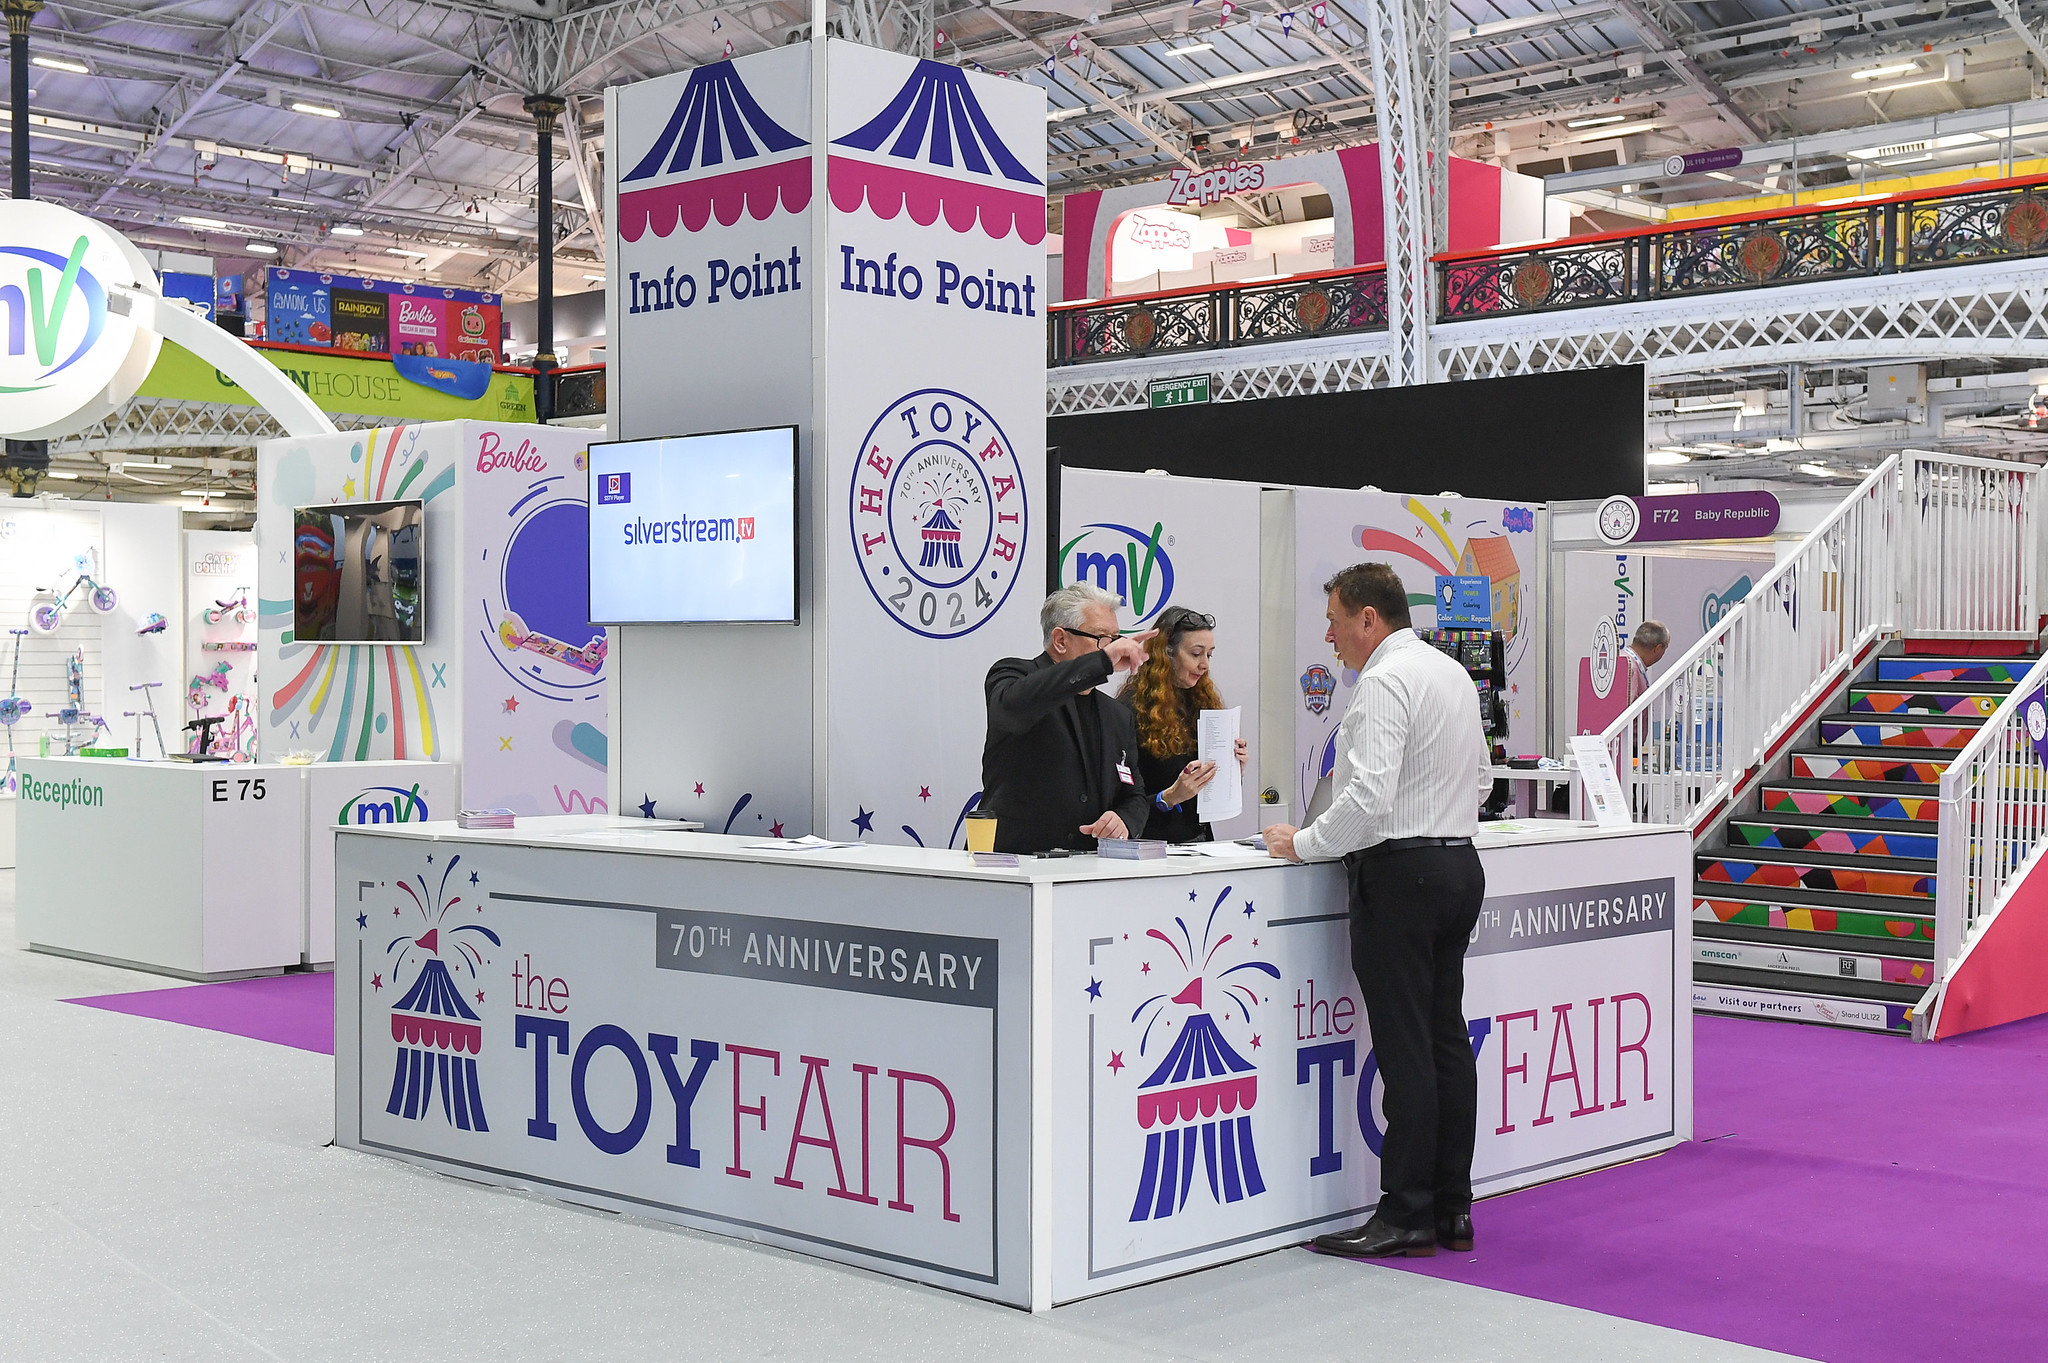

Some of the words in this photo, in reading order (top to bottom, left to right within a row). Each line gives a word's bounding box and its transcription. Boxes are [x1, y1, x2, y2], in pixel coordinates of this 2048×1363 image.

[1167, 159, 1264, 207] Zappies
[1131, 214, 1191, 250] Zappies
[1215, 250, 1247, 265] Zappies
[629, 264, 696, 314] Info
[707, 245, 801, 304] Point
[840, 244, 923, 300] Info
[936, 259, 1036, 318] Point
[273, 292, 309, 312] AMONG
[313, 296, 327, 314] US
[338, 301, 381, 316] RAINBOW
[400, 300, 436, 324] Barbie
[1152, 381, 1191, 393] EMERGENCY
[1192, 379, 1207, 388] EXIT
[499, 401, 526, 412] GREEN
[476, 431, 548, 474] Barbie
[859, 444, 894, 556] THE
[900, 401, 1018, 563] TOYFAIR
[916, 454, 983, 505] ANNIVERSARY
[1503, 508, 1523, 530] Peppa
[1523, 508, 1533, 530] Pig
[1653, 509, 1679, 524] F72
[1695, 510, 1721, 522] Baby
[1724, 507, 1770, 520] Republic
[888, 576, 994, 628] 2024
[1437, 613, 1453, 622] Color
[1454, 614, 1469, 624] Wipe
[1471, 614, 1491, 624] Repeat
[1301, 672, 1336, 696] PAW
[1307, 695, 1327, 704] PATROL
[22, 773, 103, 811] Reception
[212, 780, 228, 802] E
[237, 778, 267, 801] 75
[1509, 891, 1667, 939] ANNIVERSARY
[670, 923, 732, 958] 70TH
[743, 932, 982, 991] ANNIVERSARY
[1701, 949, 1738, 961] amscan
[512, 953, 570, 1014] the
[1293, 979, 1356, 1041] the
[1718, 995, 1740, 1007] Visit
[1742, 999, 1757, 1008] our
[1760, 1000, 1802, 1014] partners
[1841, 1010, 1860, 1020] Stand
[1861, 1012, 1881, 1022] UL122
[515, 1014, 961, 1223] TOYFAIR
